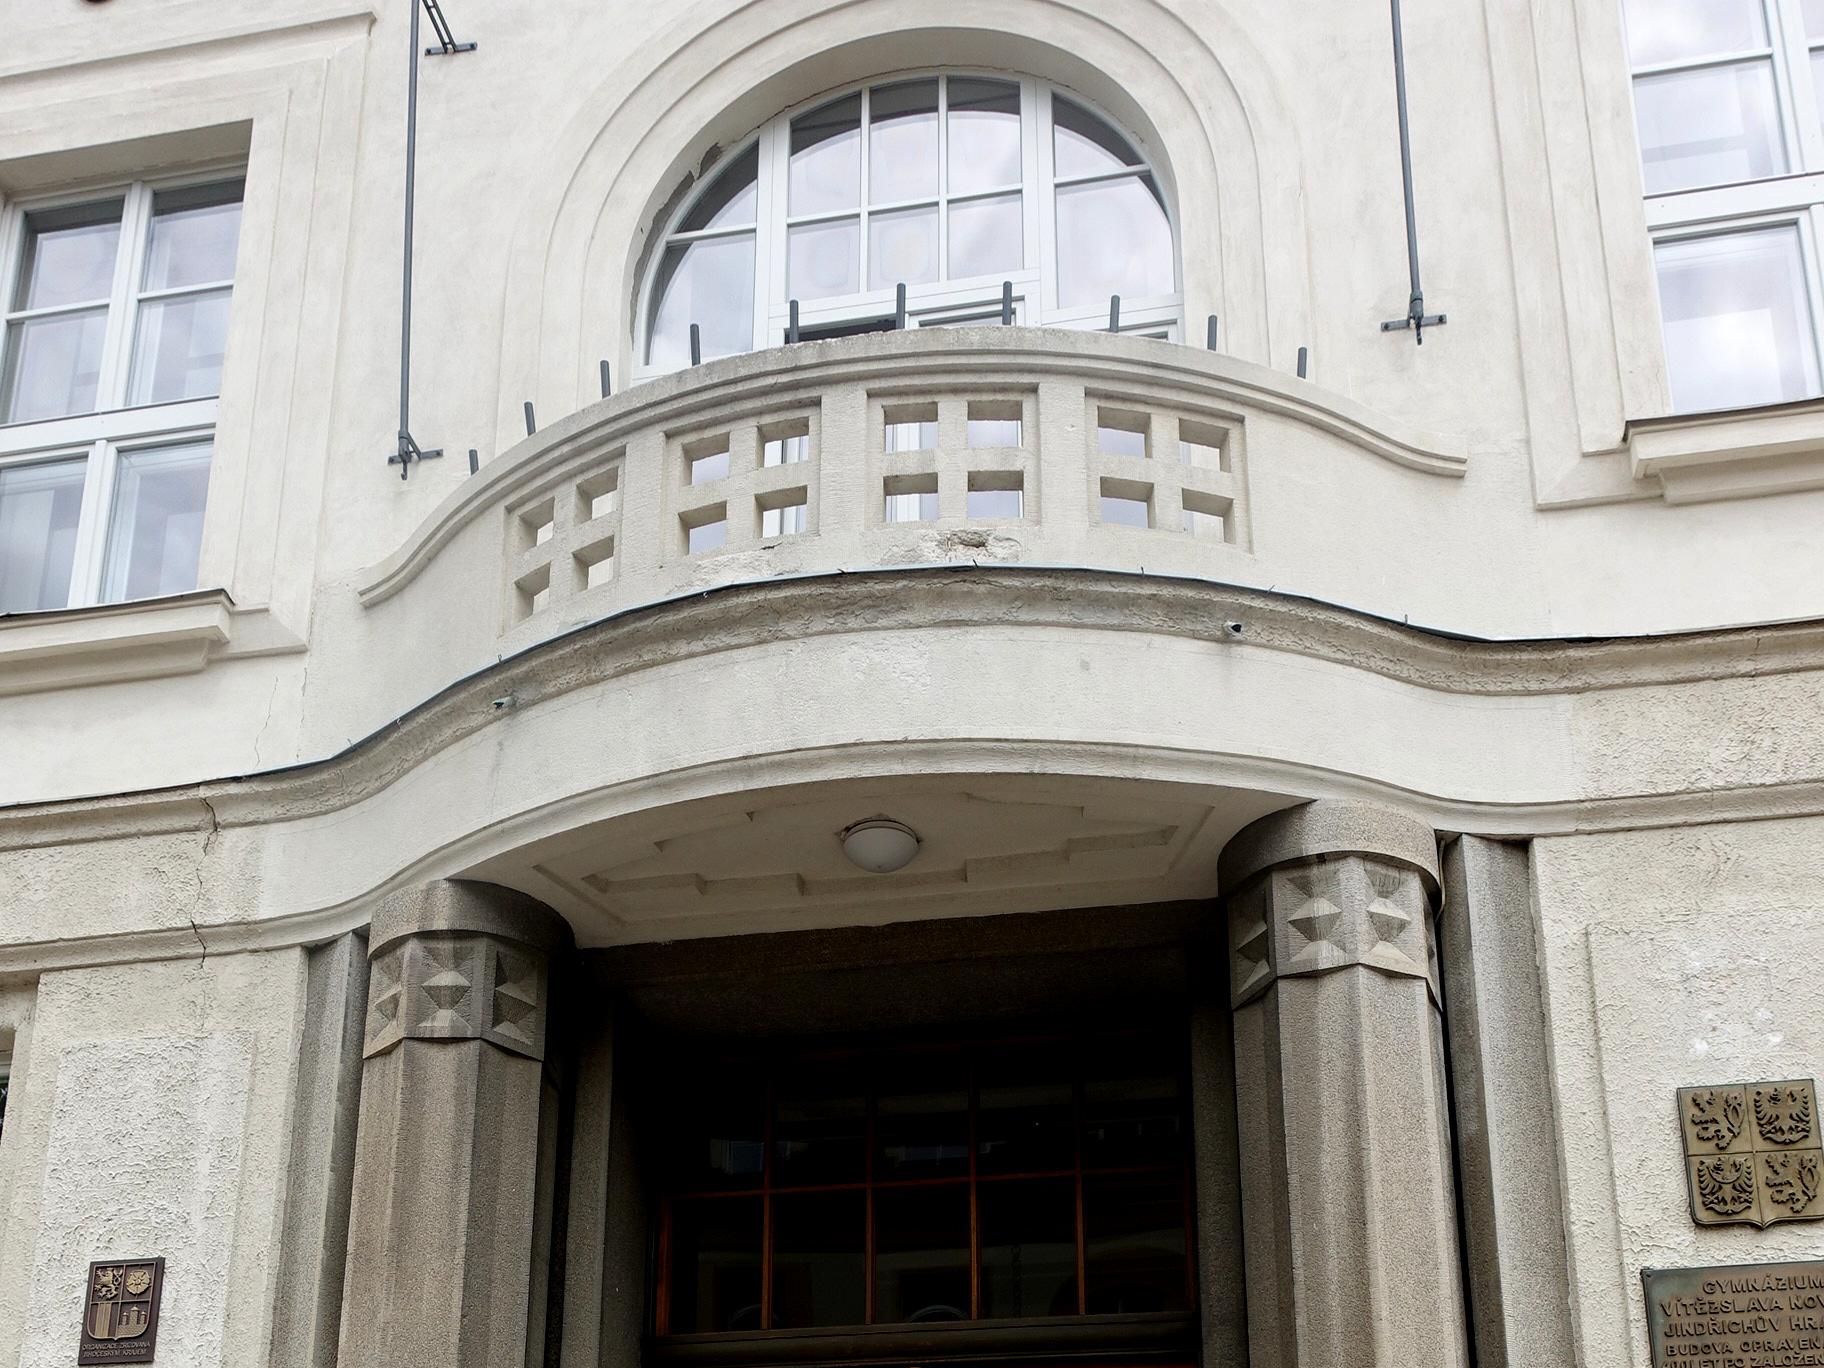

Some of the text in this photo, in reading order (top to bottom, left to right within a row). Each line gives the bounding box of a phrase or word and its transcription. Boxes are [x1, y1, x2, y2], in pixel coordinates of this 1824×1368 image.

[1660, 1296, 1783, 1317] VÍTĚZSLAVA
[1664, 1313, 1780, 1338] JINDŘICHŮV
[1666, 1341, 1733, 1357] BUDOVA
